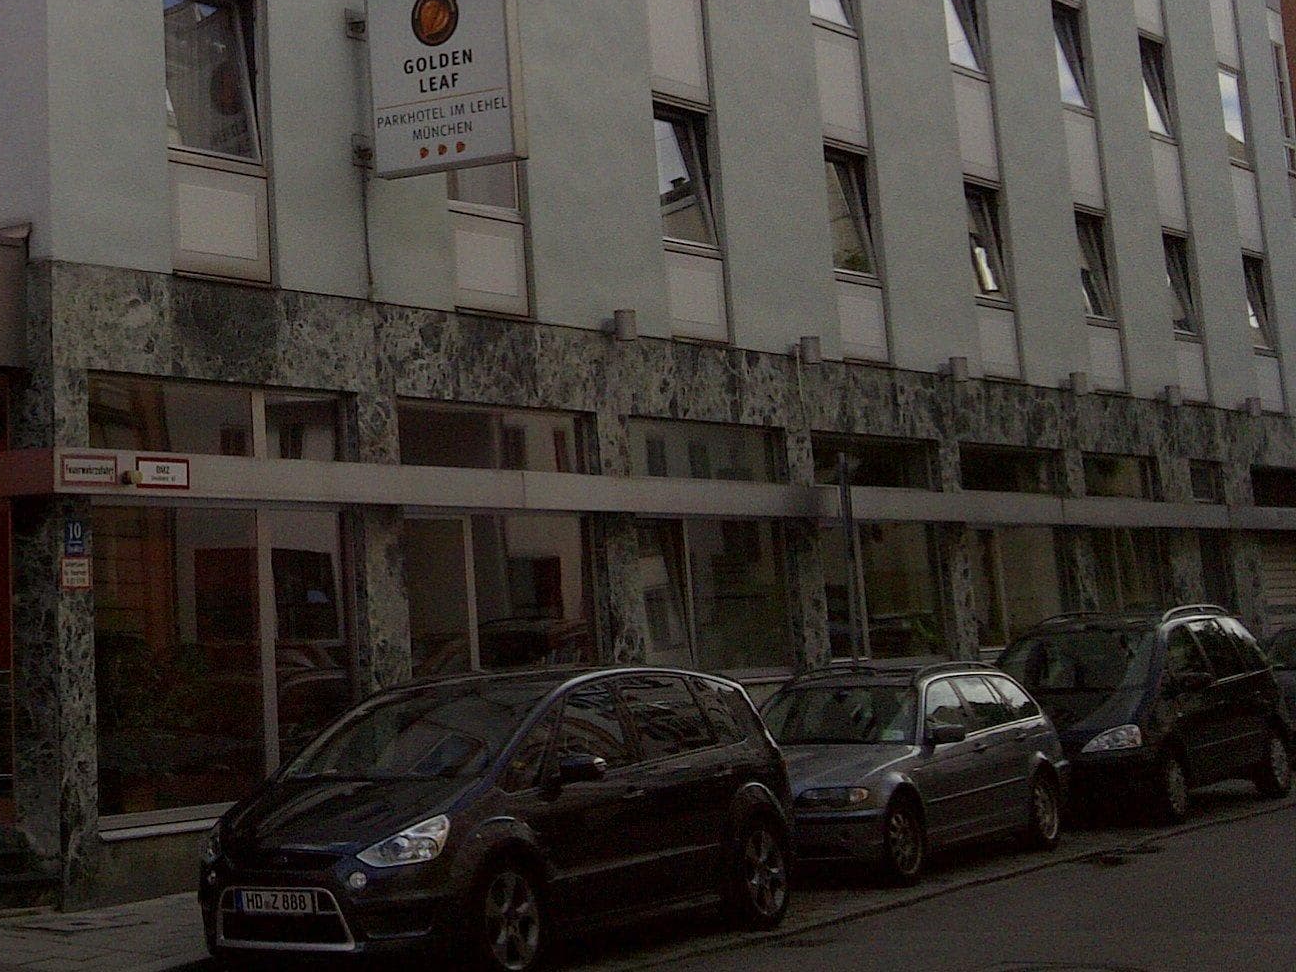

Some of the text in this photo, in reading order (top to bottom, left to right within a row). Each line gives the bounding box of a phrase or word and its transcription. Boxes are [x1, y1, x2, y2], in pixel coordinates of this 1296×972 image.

[404, 49, 472, 74] GOLDEN
[419, 73, 459, 93] LEAF
[377, 97, 508, 129] PARKHOTEL IM LEHEL
[412, 121, 473, 141] MÜNCHEN
[67, 522, 82, 540] 10
[245, 892, 264, 910] HD
